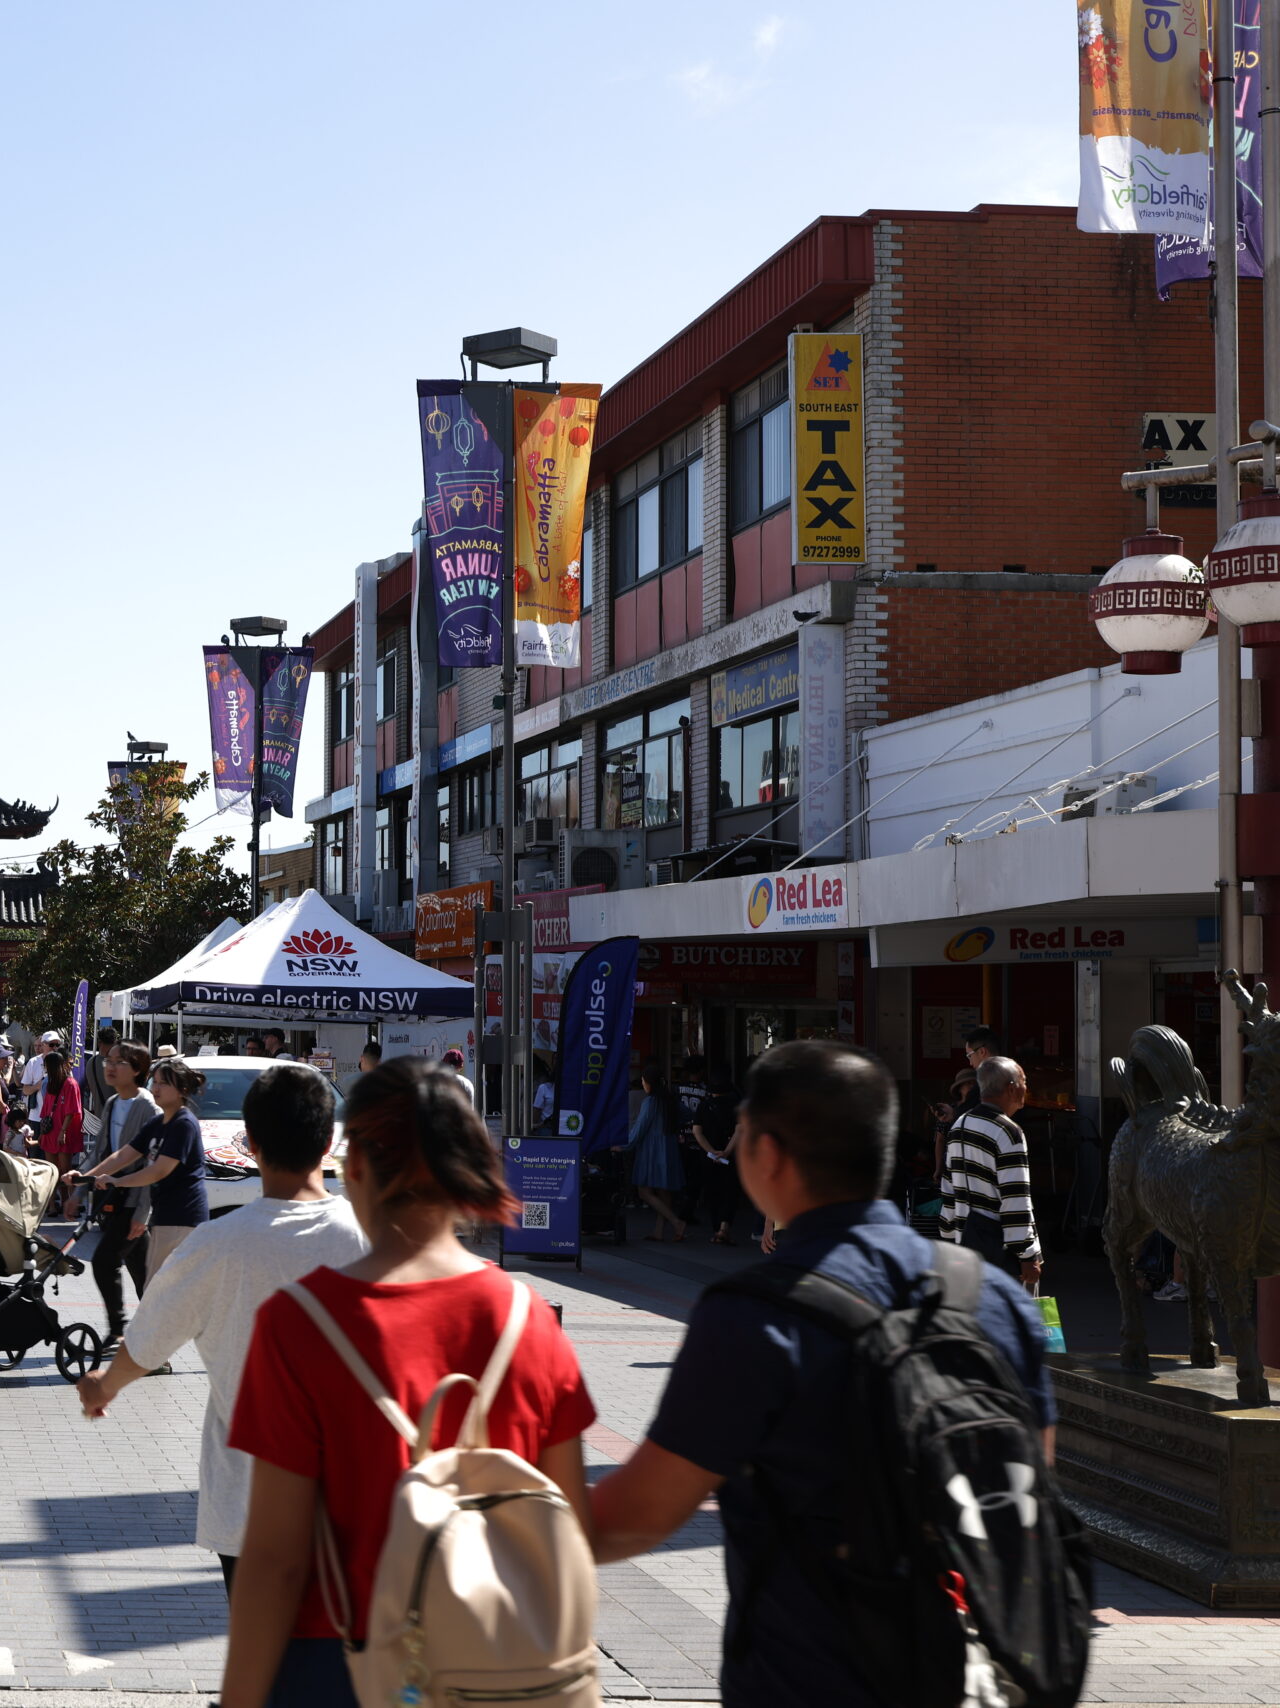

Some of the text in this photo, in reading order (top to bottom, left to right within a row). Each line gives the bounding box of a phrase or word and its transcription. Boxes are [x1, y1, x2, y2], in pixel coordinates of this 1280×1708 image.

[813, 376, 842, 388] SET
[799, 403, 859, 413] SOUTH EAST
[802, 419, 857, 529] TAX
[583, 662, 656, 709] LIFE CARE CENTRE
[728, 678, 766, 716] Medical
[262, 738, 295, 753] BRAMATTA
[262, 747, 291, 766] NAR
[269, 763, 291, 781] YEAR
[775, 873, 843, 911] Red Lea
[782, 912, 837, 925] farm fresh chickens
[1009, 926, 1125, 950] Red Lea
[671, 945, 805, 966] BUTCHERY
[1019, 949, 1112, 960] farm fresh chickens
[285, 957, 359, 973] NSW
[195, 986, 419, 1011] Drive electric NSW
[550, 1157, 576, 1165] charging
